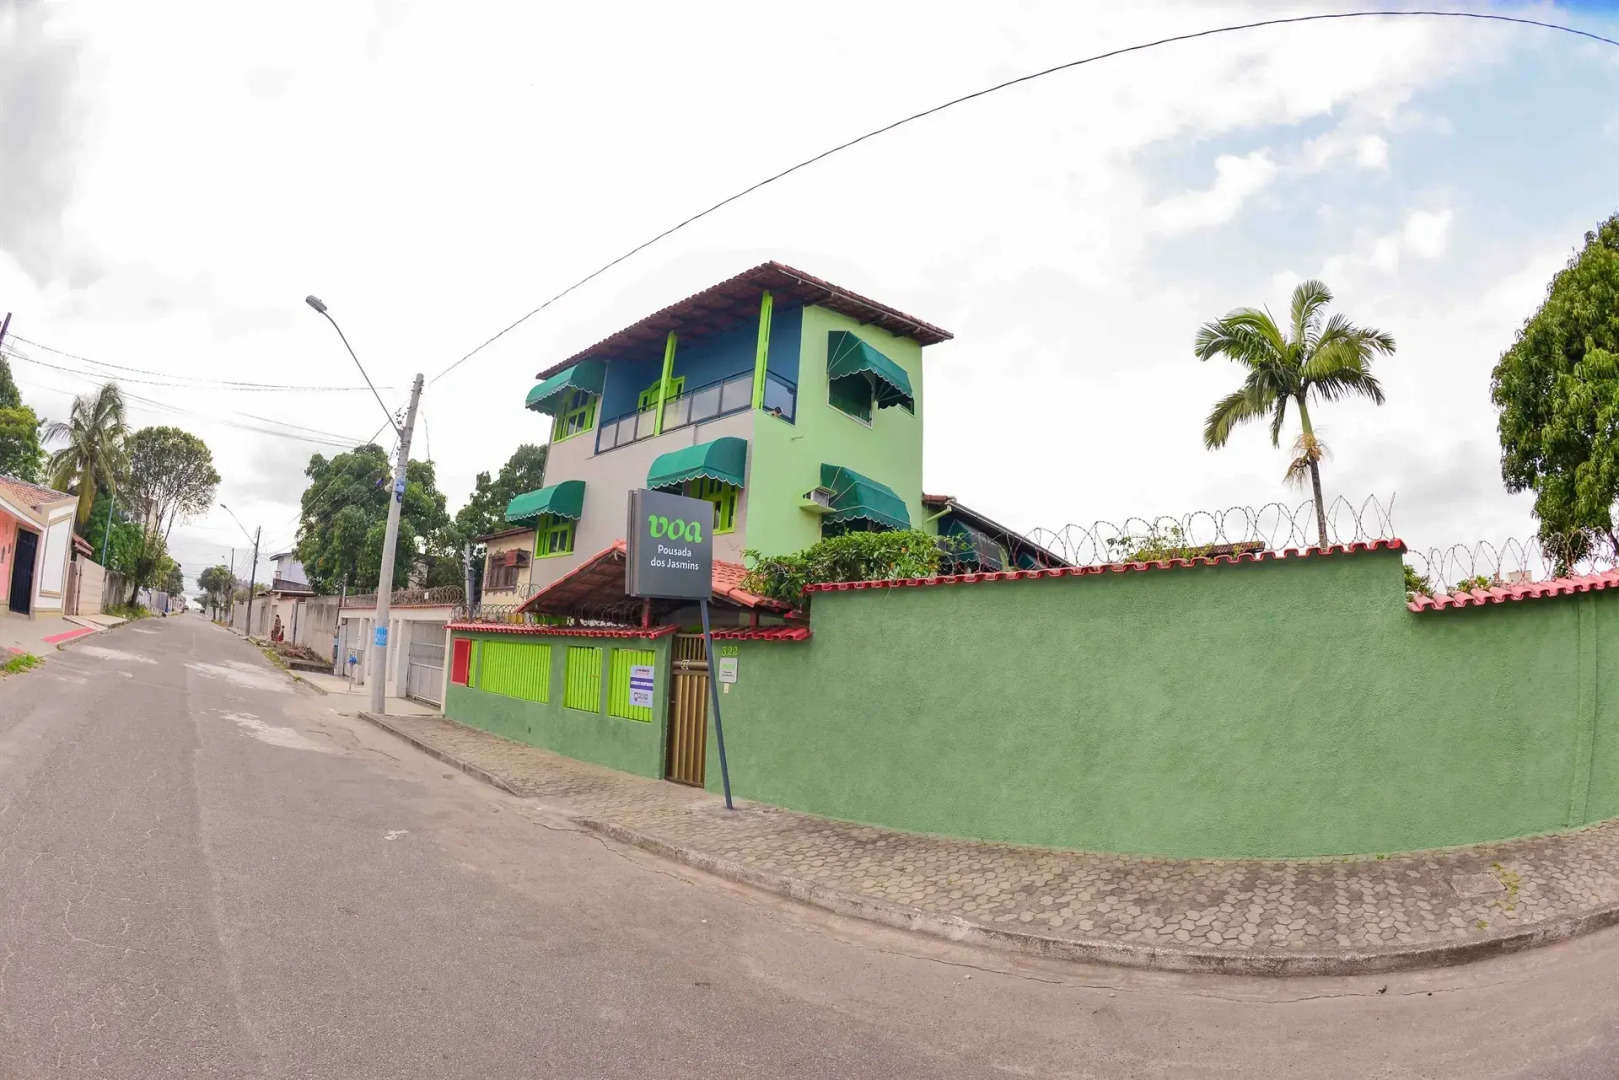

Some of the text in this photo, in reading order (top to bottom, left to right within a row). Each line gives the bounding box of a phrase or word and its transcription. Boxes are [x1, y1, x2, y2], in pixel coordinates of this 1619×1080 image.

[648, 515, 702, 543] voa
[657, 544, 692, 557] Pousada
[650, 556, 699, 570] dos Jasmins
[721, 645, 738, 656] 322
